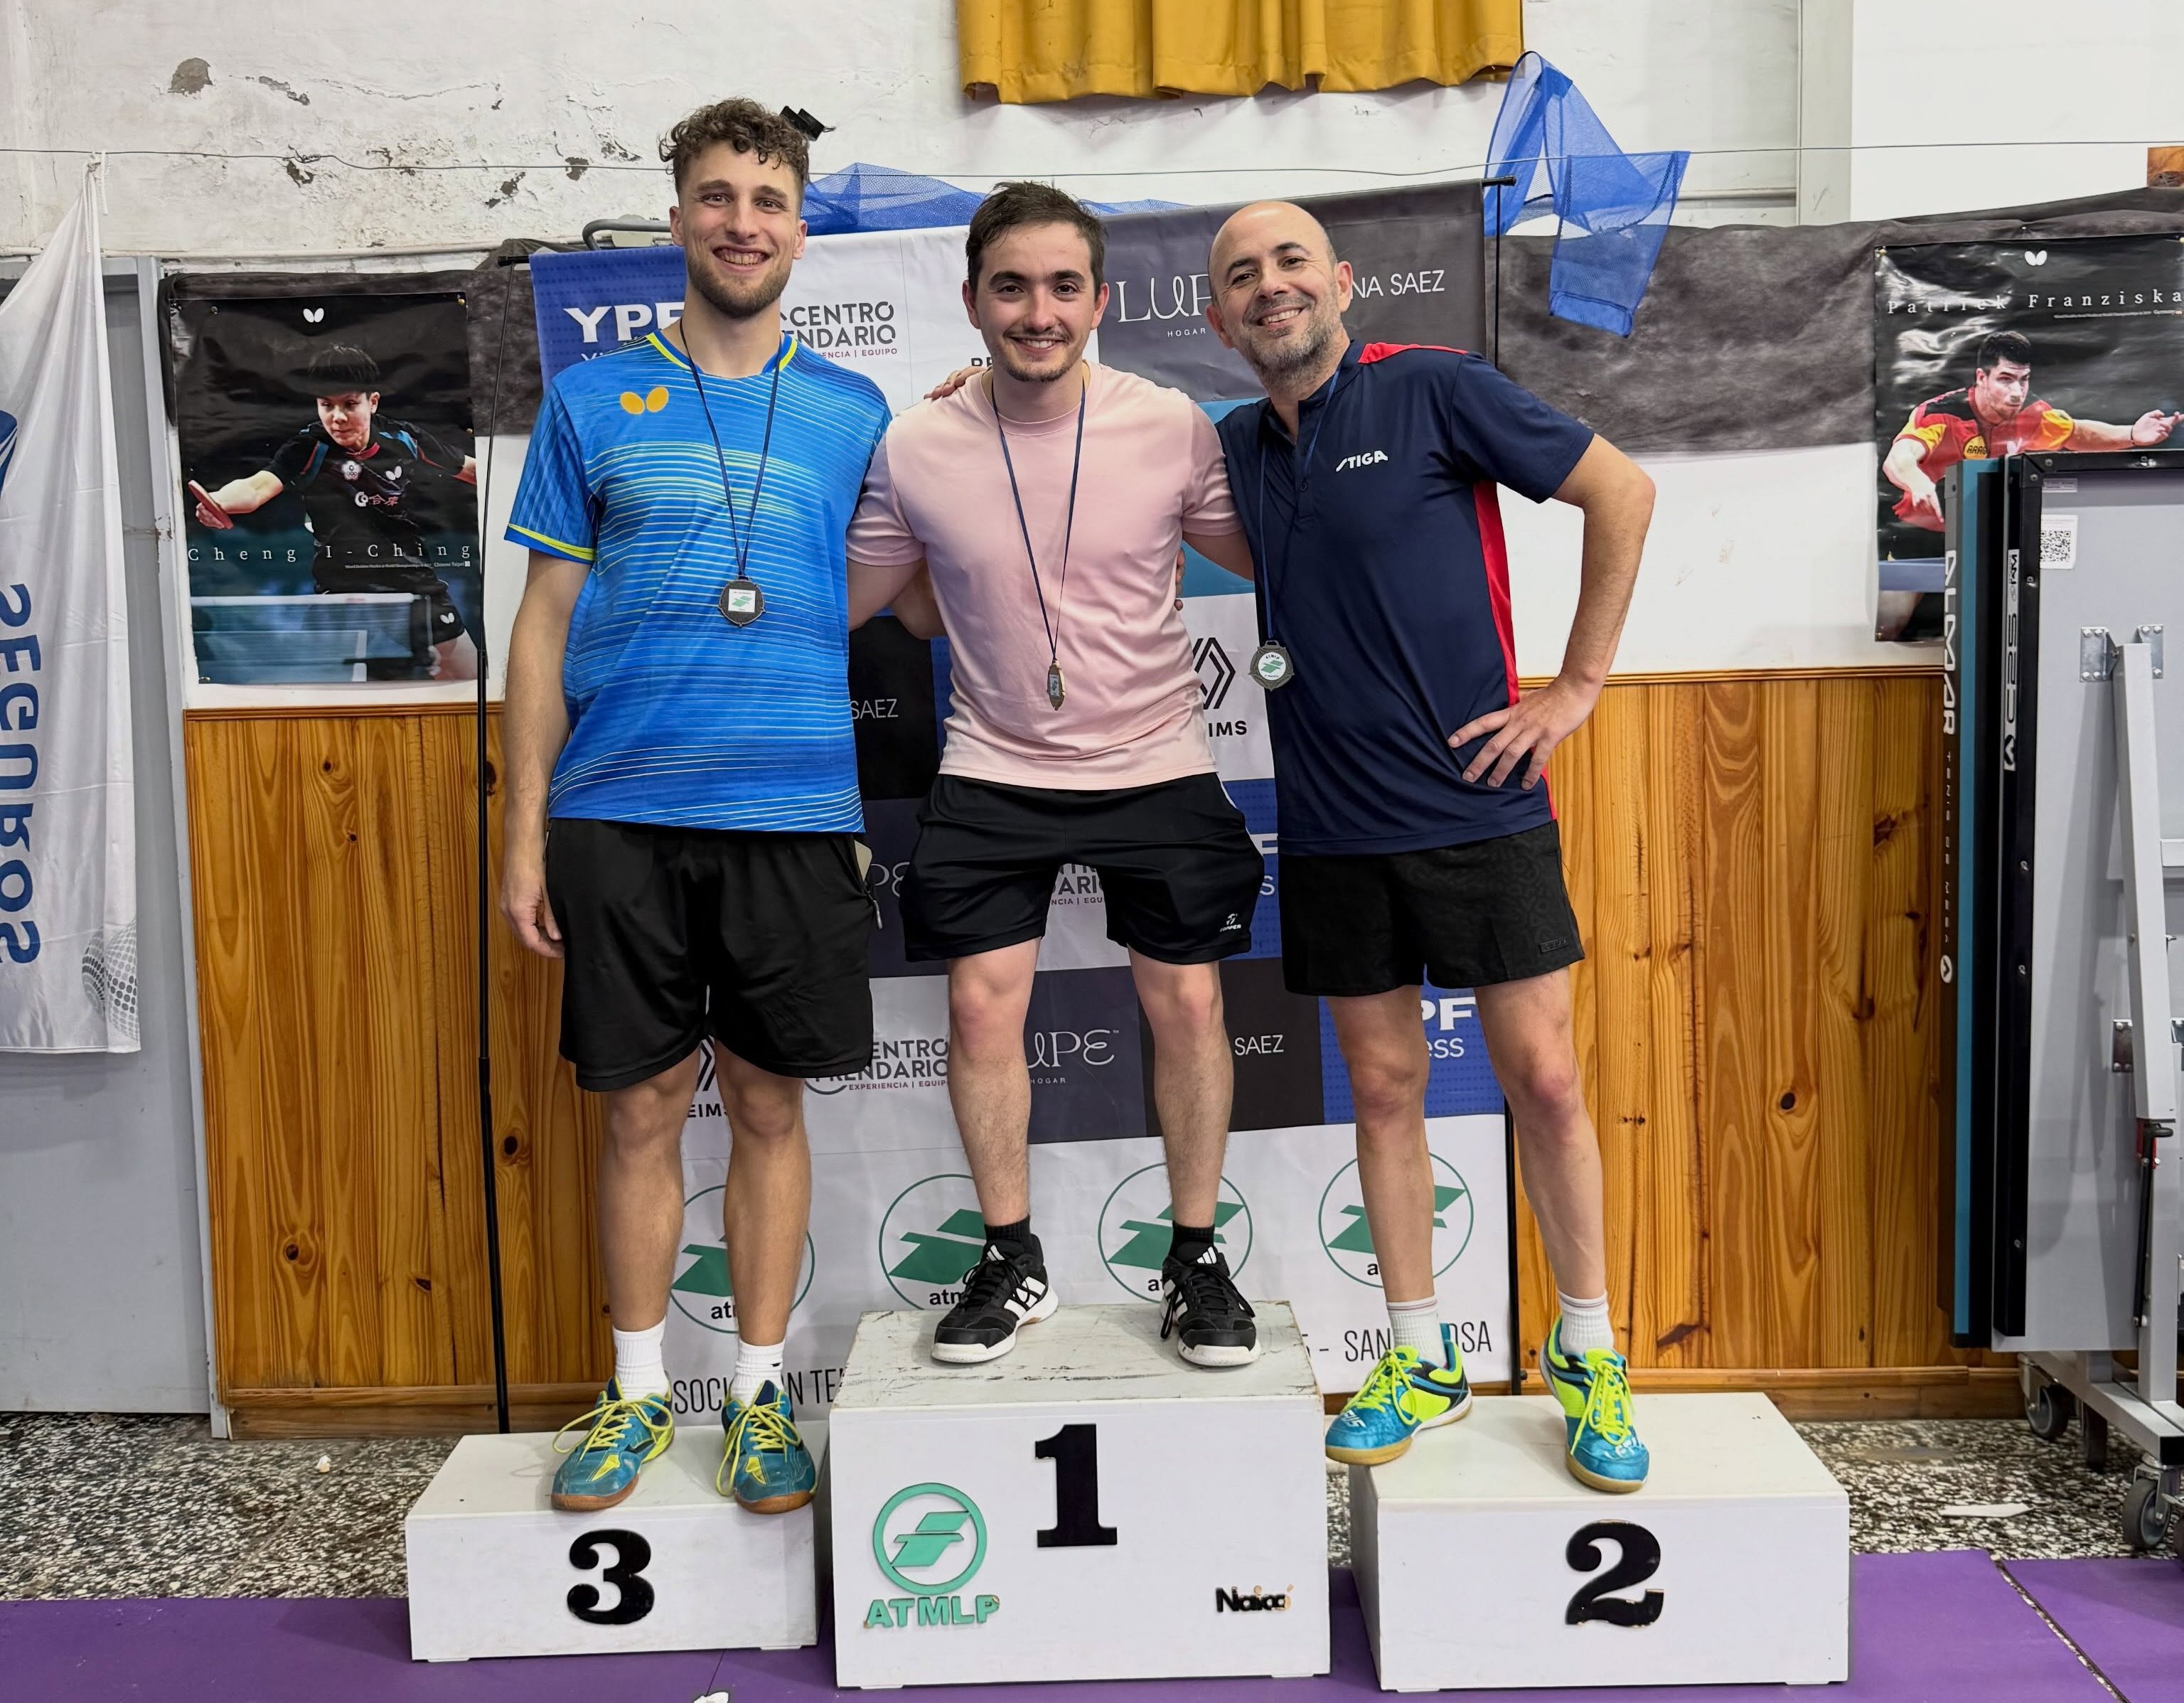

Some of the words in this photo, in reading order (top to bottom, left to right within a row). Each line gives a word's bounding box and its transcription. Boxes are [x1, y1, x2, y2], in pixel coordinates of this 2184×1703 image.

[1351, 276, 1384, 299] NA
[1390, 269, 1445, 296] SAEZ
[2028, 289, 2182, 308] Franziska
[786, 324, 896, 349] NDARIO
[1167, 328, 1206, 337] HOGAR
[862, 348, 897, 356] EQUIPO
[1336, 450, 1388, 472] STIGA
[188, 547, 296, 562] Cheng
[850, 698, 899, 720] SAEZ
[1208, 720, 1247, 737] IMS
[872, 1038, 948, 1059] ENTRO
[1234, 1035, 1284, 1056] SAEZ
[849, 1082, 909, 1091] EXPERIENCIA
[1344, 1328, 1391, 1362] SAN
[1034, 1424, 1118, 1548] 1
[567, 1529, 655, 1625] 3
[1565, 1520, 1664, 1628] 2
[864, 1595, 1000, 1629] ATMLP
